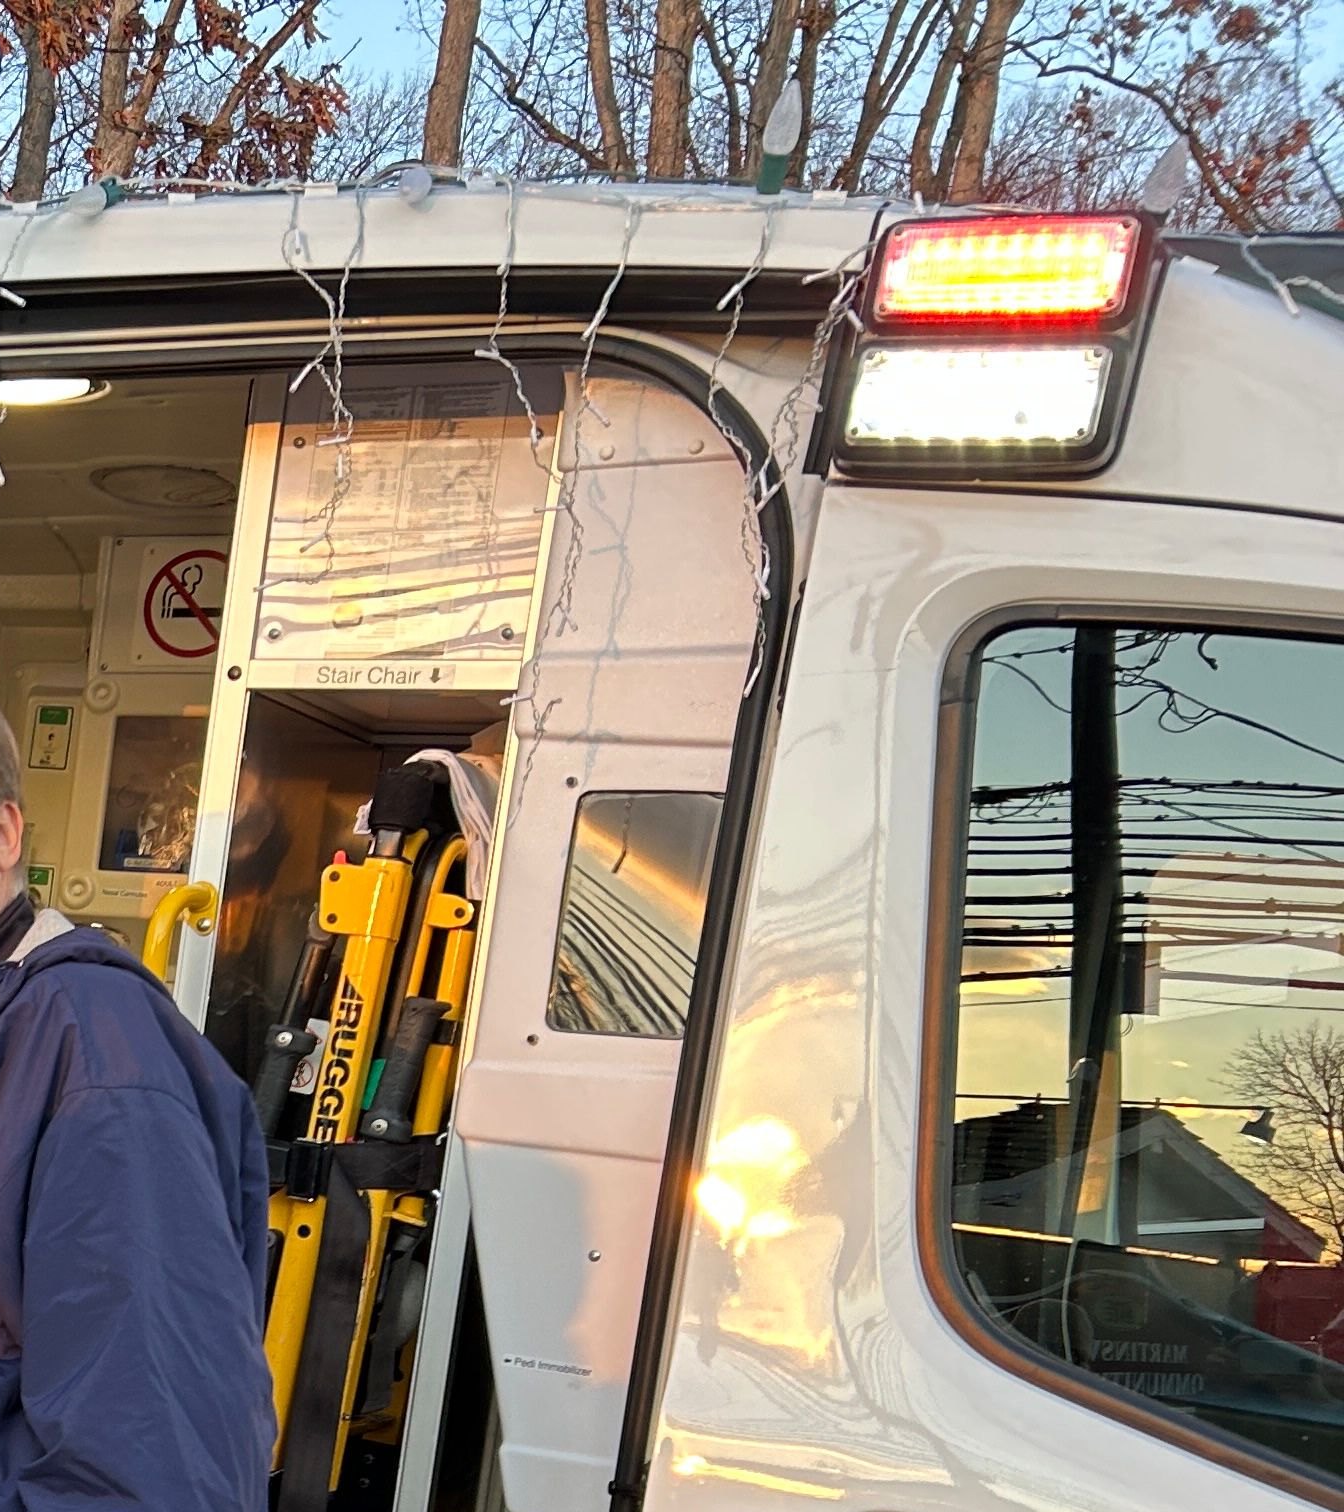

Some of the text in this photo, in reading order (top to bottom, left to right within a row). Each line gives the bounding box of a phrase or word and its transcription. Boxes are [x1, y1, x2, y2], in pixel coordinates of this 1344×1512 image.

[316, 666, 421, 685] Stair Chair
[313, 1002, 365, 1144] RUGGE
